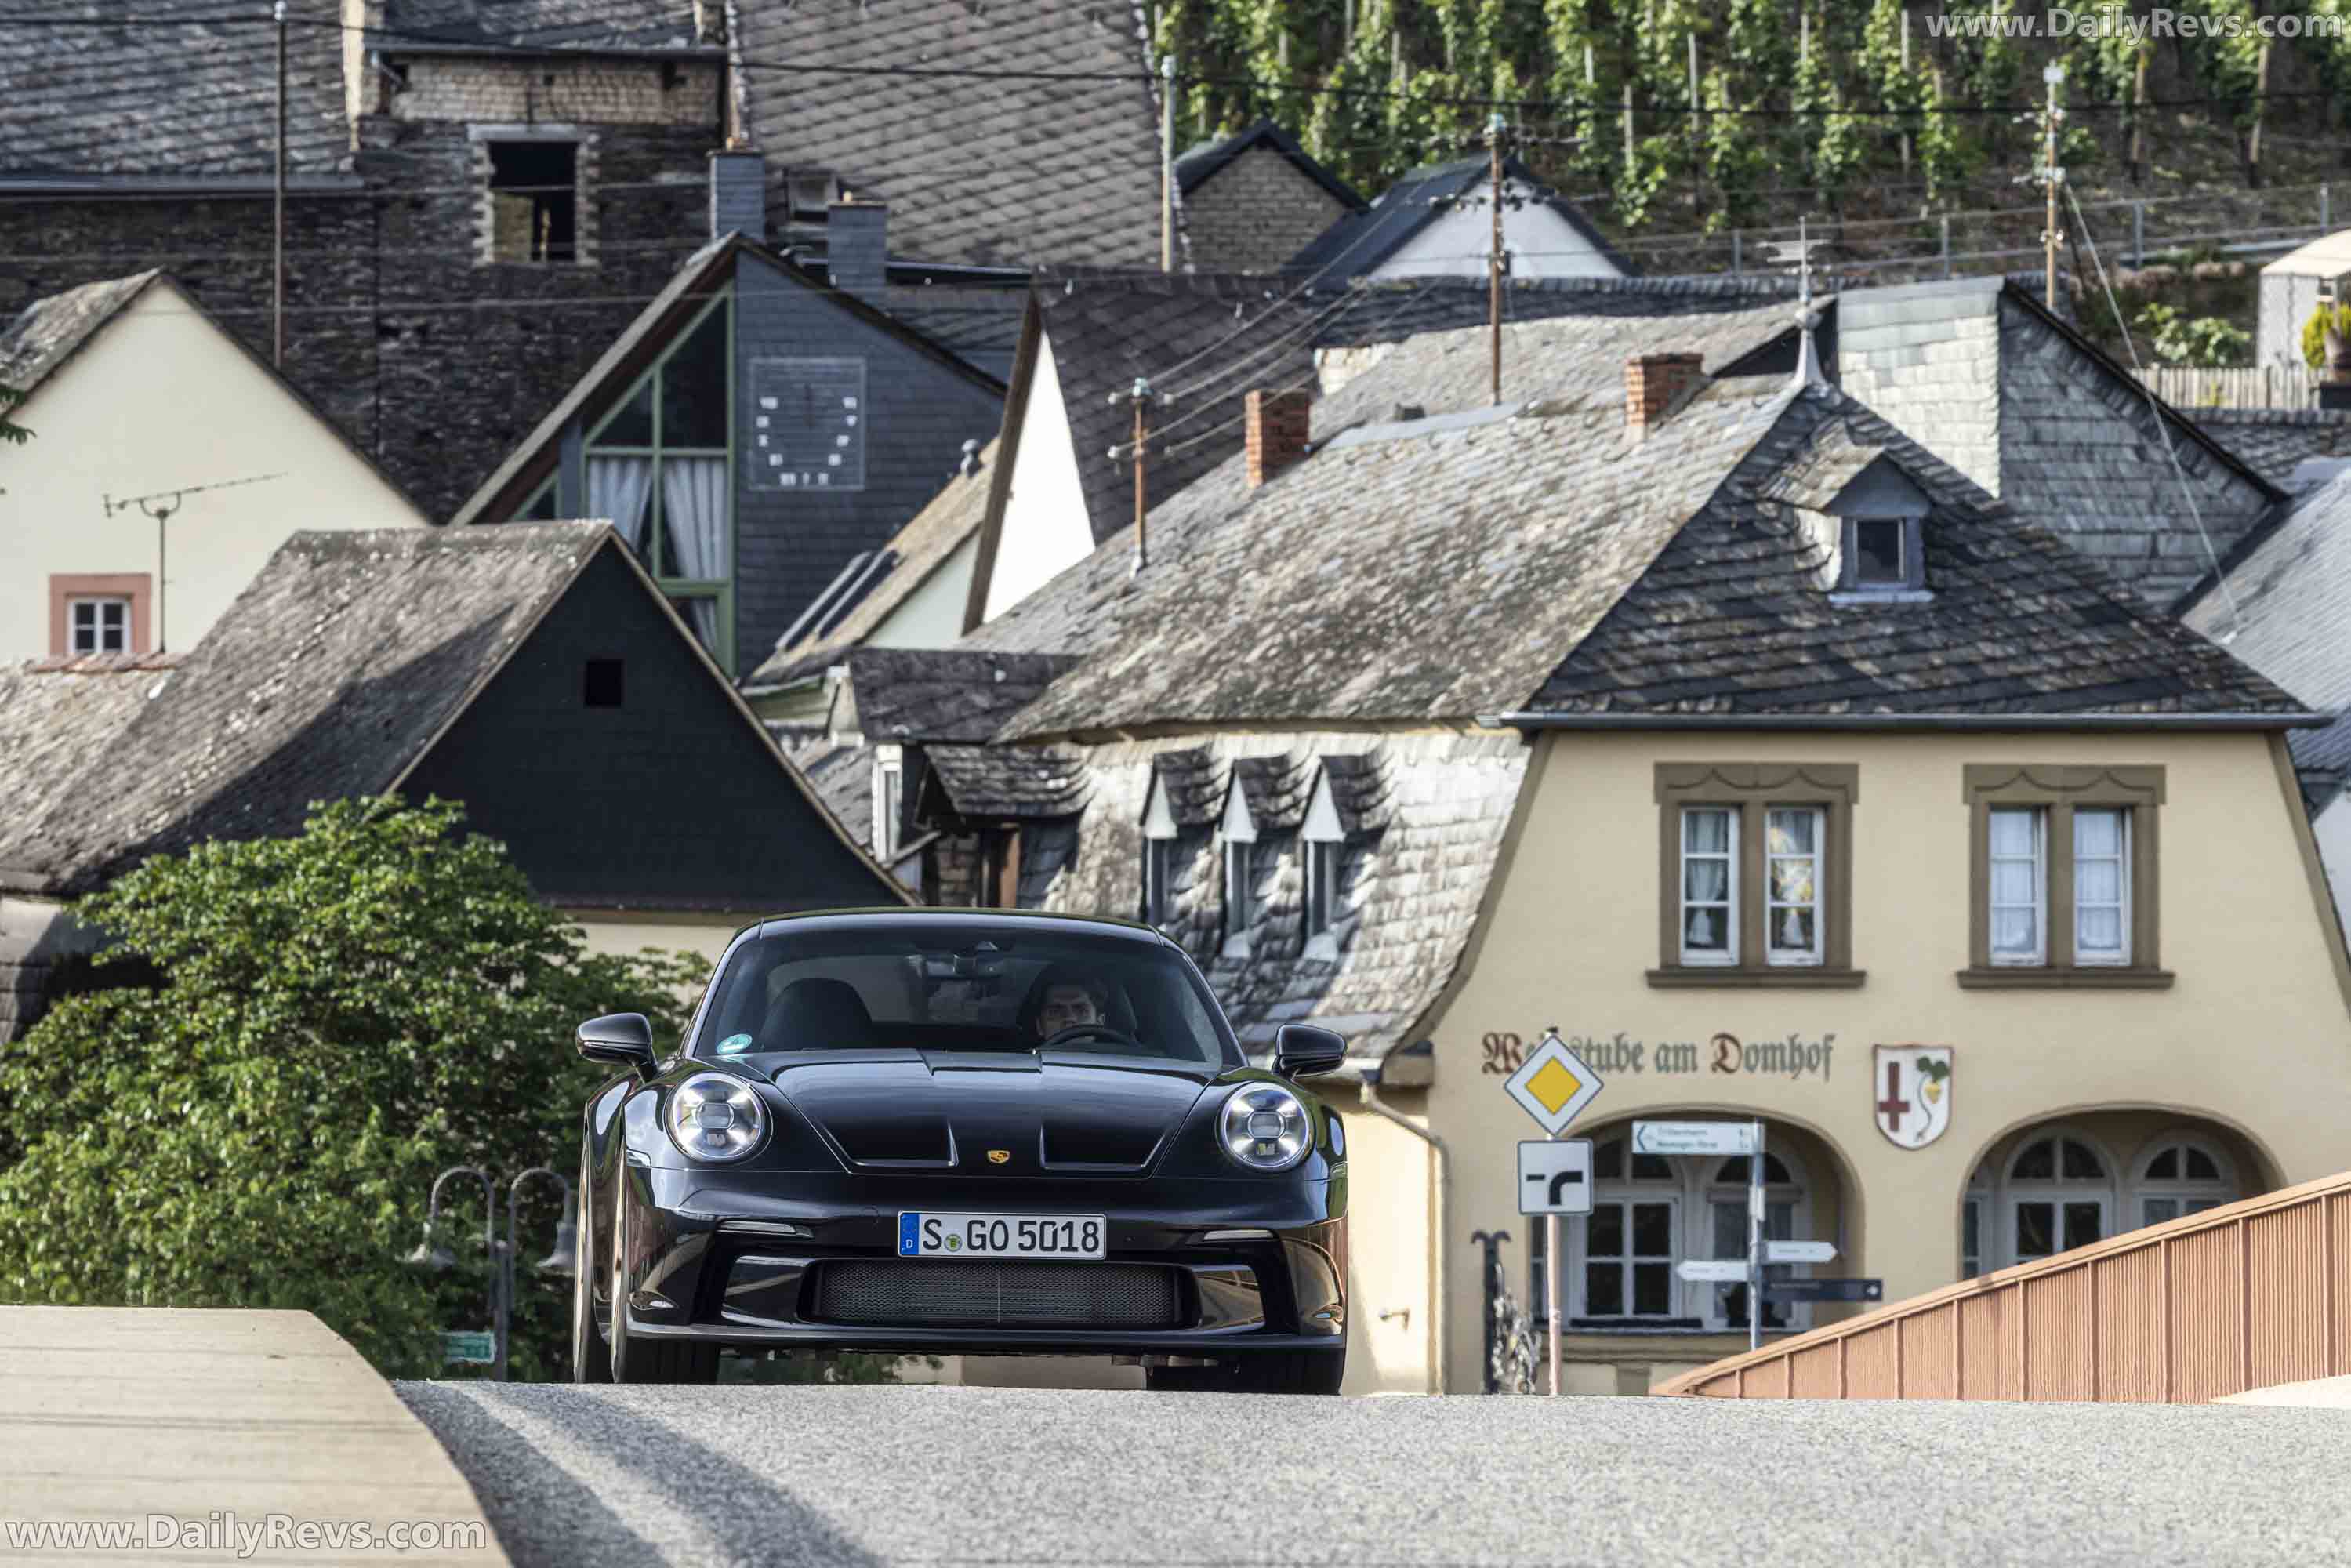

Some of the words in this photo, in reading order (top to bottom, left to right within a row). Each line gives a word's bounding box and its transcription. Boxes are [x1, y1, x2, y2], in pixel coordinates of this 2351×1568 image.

[1656, 1042, 1699, 1073] am
[1710, 1032, 1836, 1083] Domhof
[905, 1239, 913, 1249] D
[922, 1218, 942, 1250] S
[967, 1219, 1010, 1252] GO
[1018, 1220, 1099, 1253] 5018
